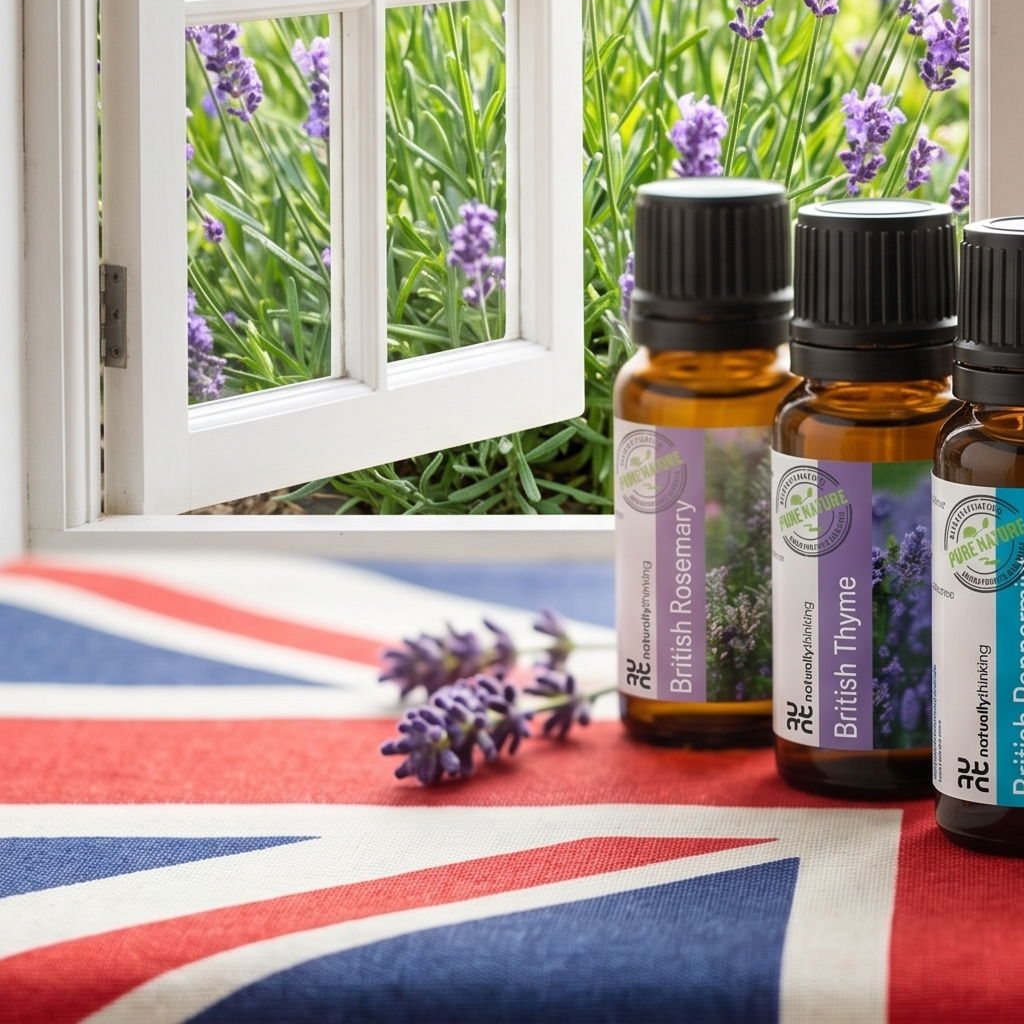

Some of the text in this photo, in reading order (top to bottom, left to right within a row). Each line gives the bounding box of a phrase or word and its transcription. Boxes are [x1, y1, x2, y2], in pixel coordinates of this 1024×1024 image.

[669, 500, 696, 694] British Rosemary
[948, 541, 979, 569] PURE
[834, 576, 861, 739] British Thyme
